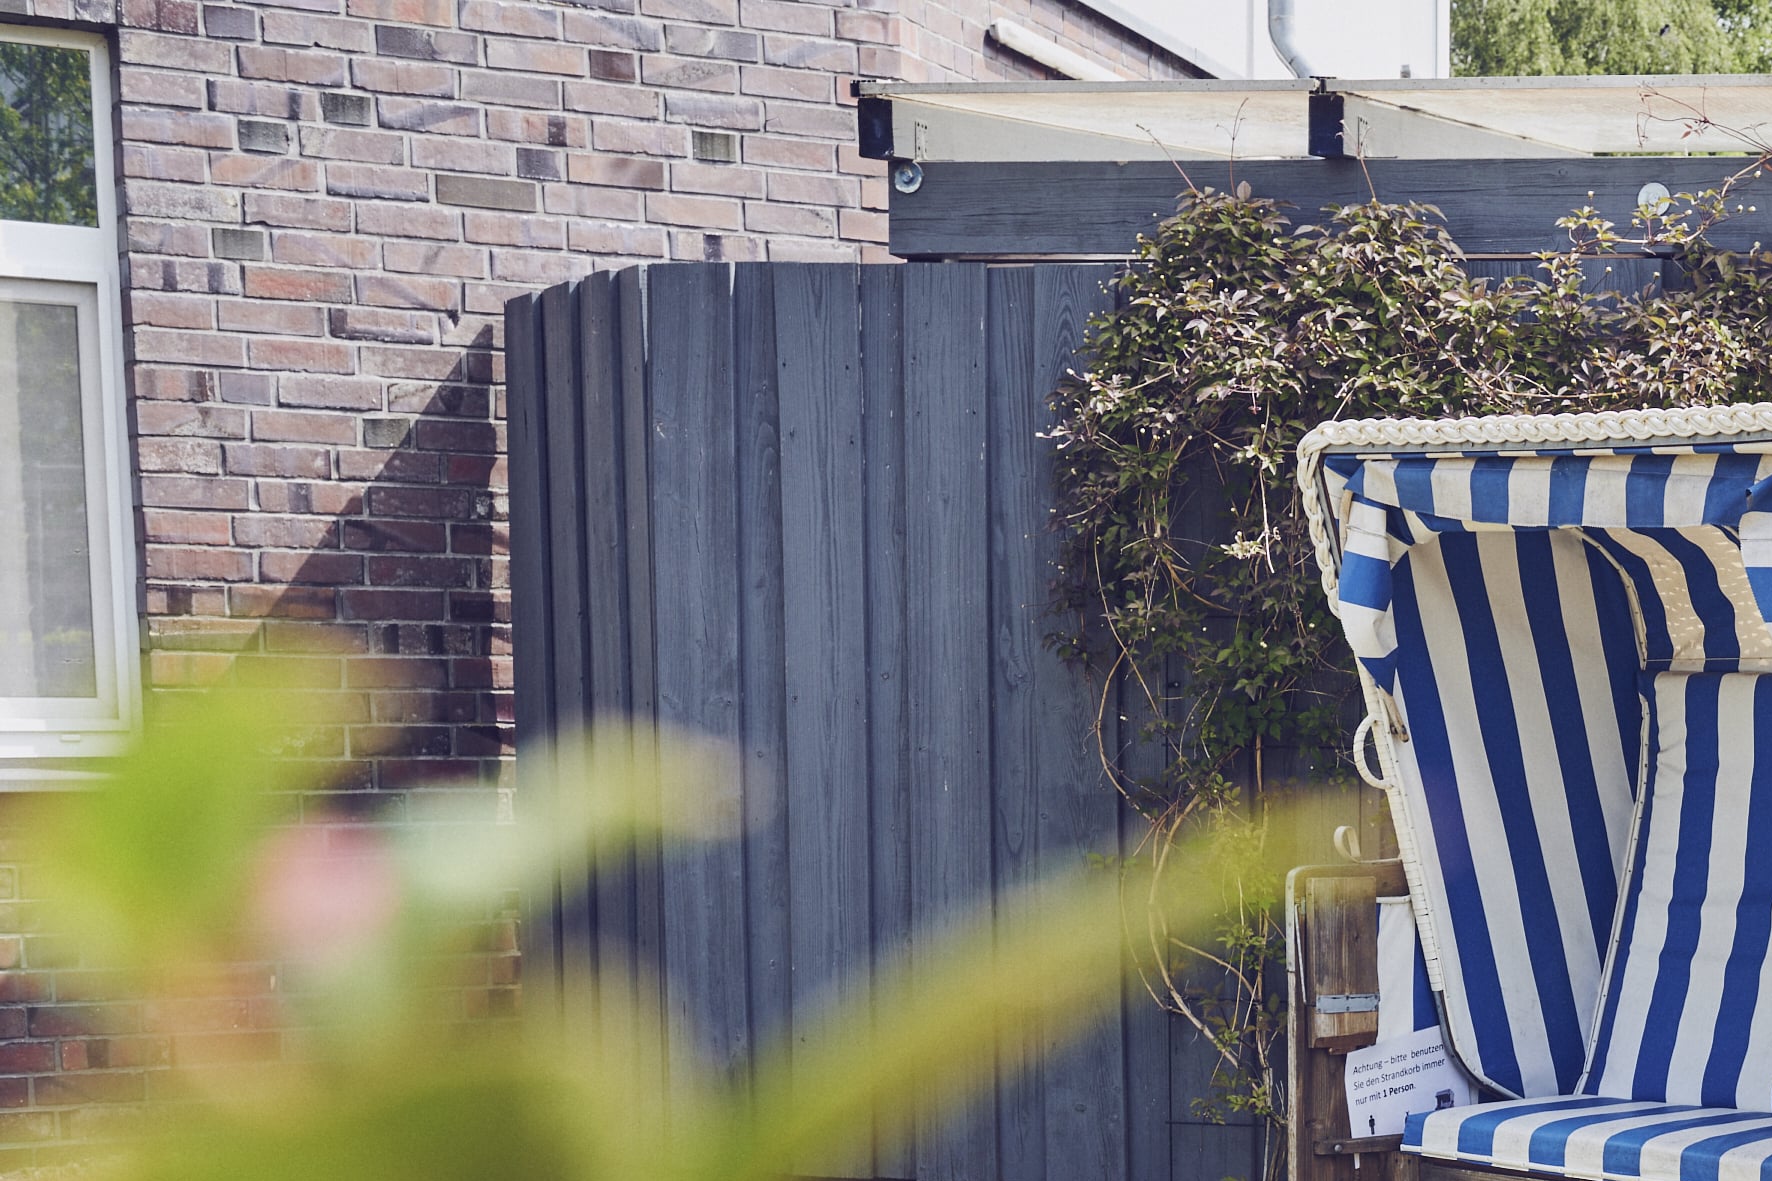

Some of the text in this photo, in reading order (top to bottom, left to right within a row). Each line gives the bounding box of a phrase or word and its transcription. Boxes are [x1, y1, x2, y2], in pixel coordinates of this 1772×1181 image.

[1353, 1061, 1383, 1075] Achtung
[1391, 1053, 1407, 1065] bitte
[1411, 1044, 1443, 1059] benutzen
[1353, 1058, 1445, 1091] Sie den Strandkorb immer
[1355, 1082, 1416, 1106] nur mit 1 Person.
